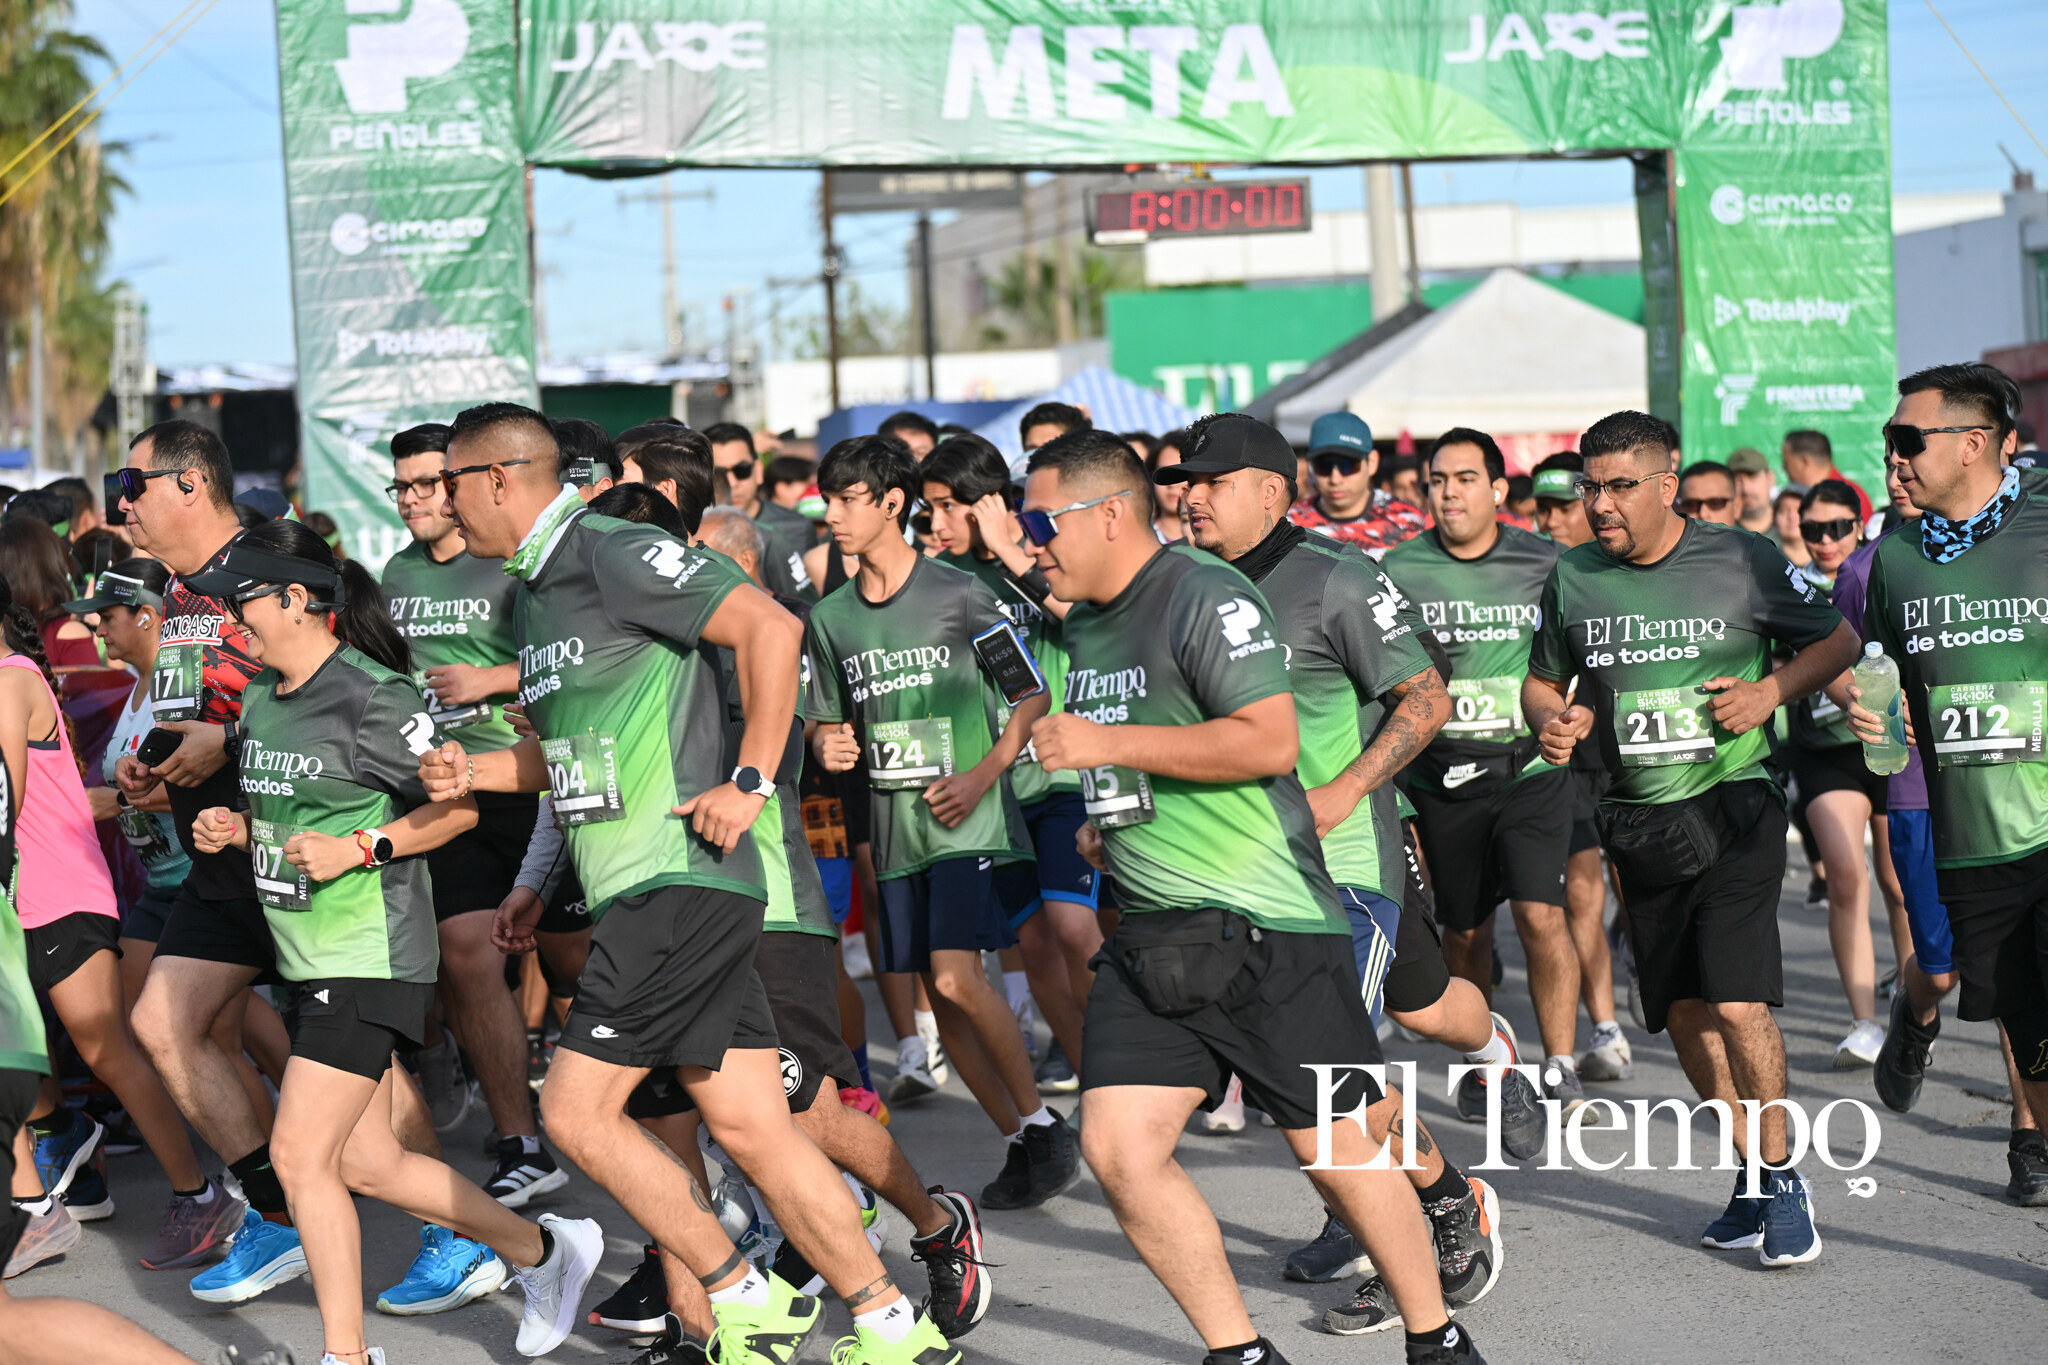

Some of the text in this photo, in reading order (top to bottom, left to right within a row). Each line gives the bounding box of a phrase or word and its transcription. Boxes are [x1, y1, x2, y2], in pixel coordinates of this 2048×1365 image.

[941, 24, 1295, 120] META
[1744, 296, 1851, 325] Totalplay
[371, 325, 488, 357] Totalplay
[1765, 384, 1865, 403] FRONTERA
[390, 596, 491, 621] El Tiempo
[1419, 601, 1538, 627] El Tiempo
[1902, 593, 2048, 631] El Tiempo
[160, 614, 224, 640] RONCAST
[407, 620, 468, 637] todos
[1432, 626, 1520, 643] e todos
[1584, 614, 1726, 646] El Tiempo
[1906, 625, 2024, 655] de todos
[523, 636, 584, 678] Tiempo
[841, 645, 950, 685] El Tiempo
[1586, 644, 1700, 668] de todos
[154, 667, 184, 699] 171
[524, 674, 562, 703] todos
[853, 672, 934, 703] de todos
[1075, 665, 1146, 702] Tiempo
[1637, 689, 1680, 698] CARRERA
[1951, 684, 1994, 693] CARRERA
[2029, 686, 2044, 694] 212
[1455, 694, 1497, 721] 02
[1941, 704, 2009, 740] 212
[1627, 708, 1698, 742] 213
[2031, 699, 2043, 752] MEDALLA
[600, 737, 614, 746] 204
[871, 739, 925, 768] 124
[941, 733, 953, 778] MEDALLA
[244, 739, 323, 780] Tiempo
[1448, 762, 1477, 778] NIKE
[243, 775, 294, 796] todos
[604, 750, 620, 809] MEDALLA
[1136, 770, 1152, 810] MEDA
[461, 1250, 486, 1280] HOKA
